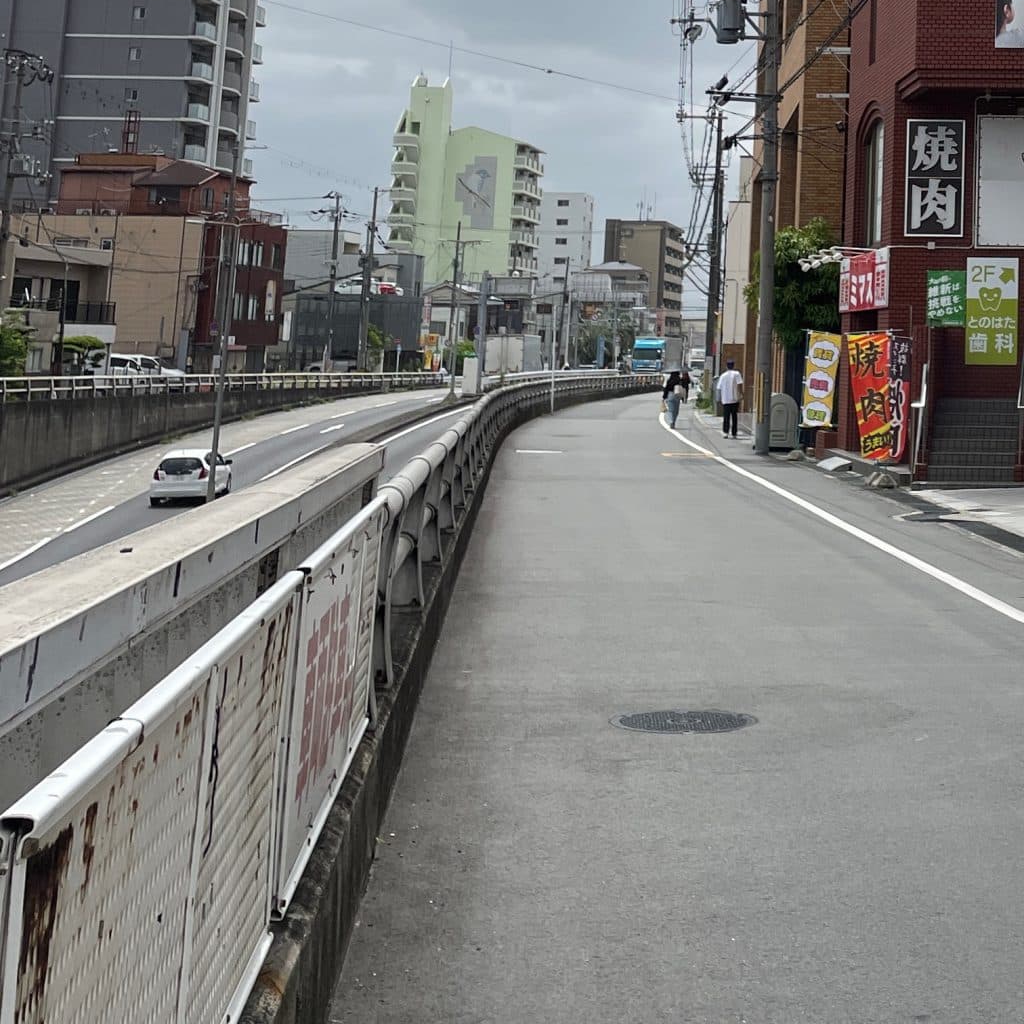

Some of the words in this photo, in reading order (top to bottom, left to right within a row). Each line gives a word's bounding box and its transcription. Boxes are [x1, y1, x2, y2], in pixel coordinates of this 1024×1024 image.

[911, 125, 959, 230] 焼肉
[971, 265, 996, 283] 2F
[968, 315, 1016, 329] とのはた
[968, 332, 1015, 354] 歯科
[851, 341, 888, 424] 焼肉
